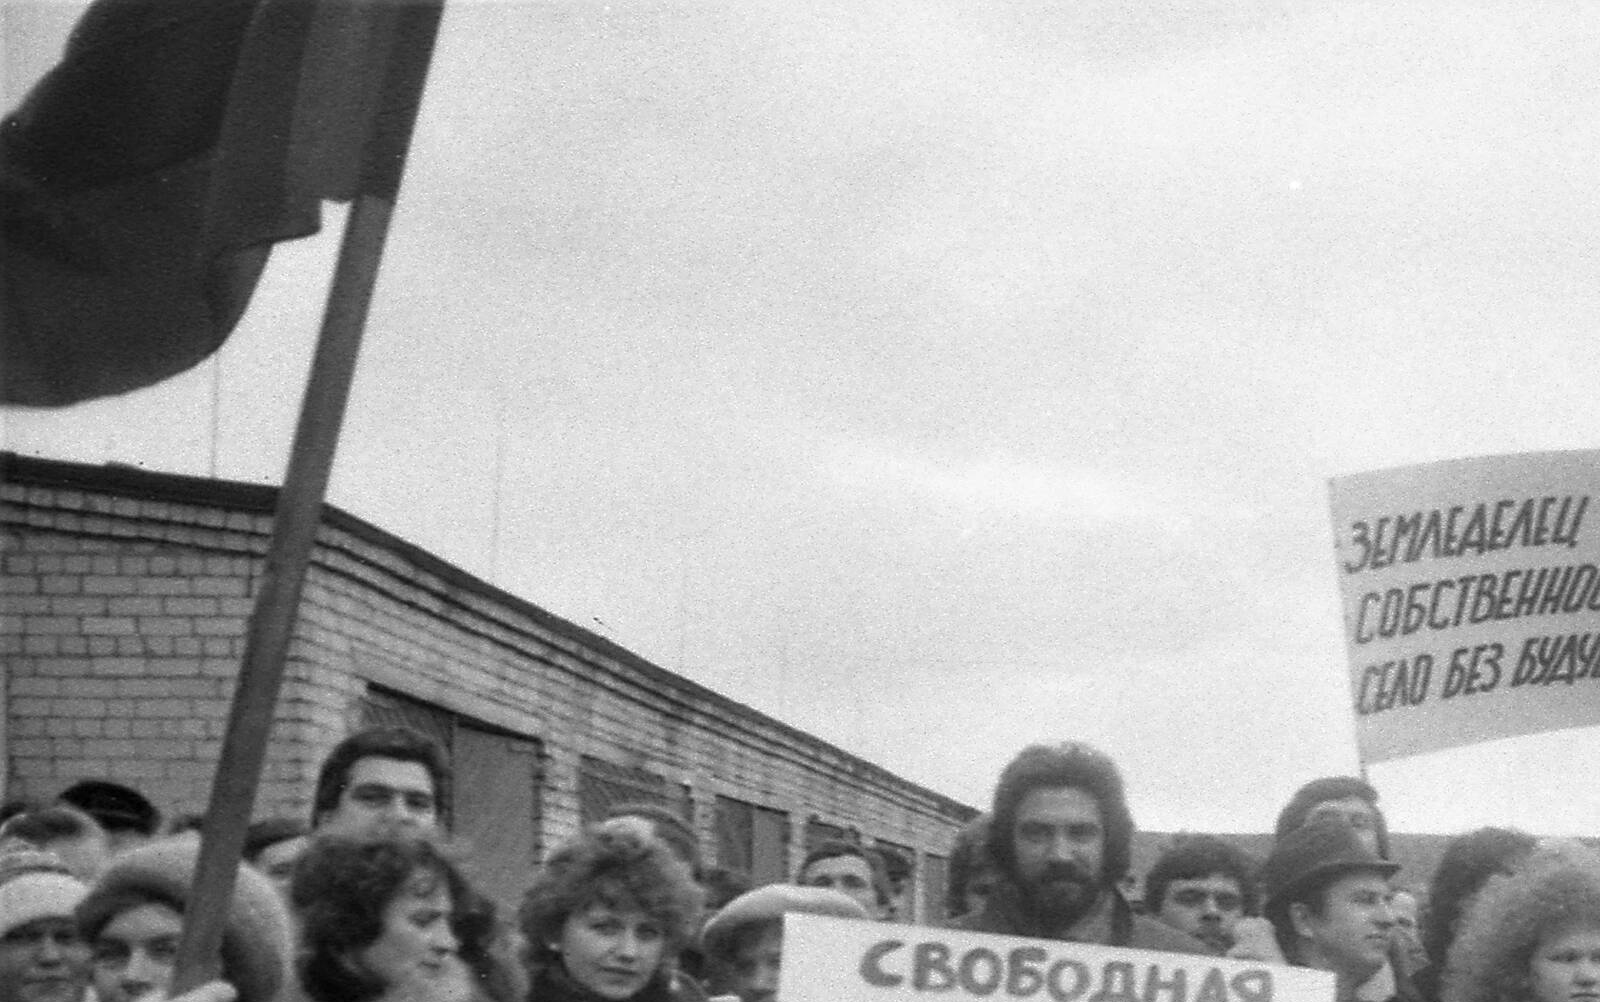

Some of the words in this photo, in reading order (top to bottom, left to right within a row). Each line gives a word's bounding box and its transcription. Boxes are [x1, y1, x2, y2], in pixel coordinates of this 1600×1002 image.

[1344, 496, 1590, 574] ЗЕМЛЕДЕЛЕЦ
[1355, 653, 1434, 716] СЕЛО
[1442, 642, 1504, 699] БЕЗ
